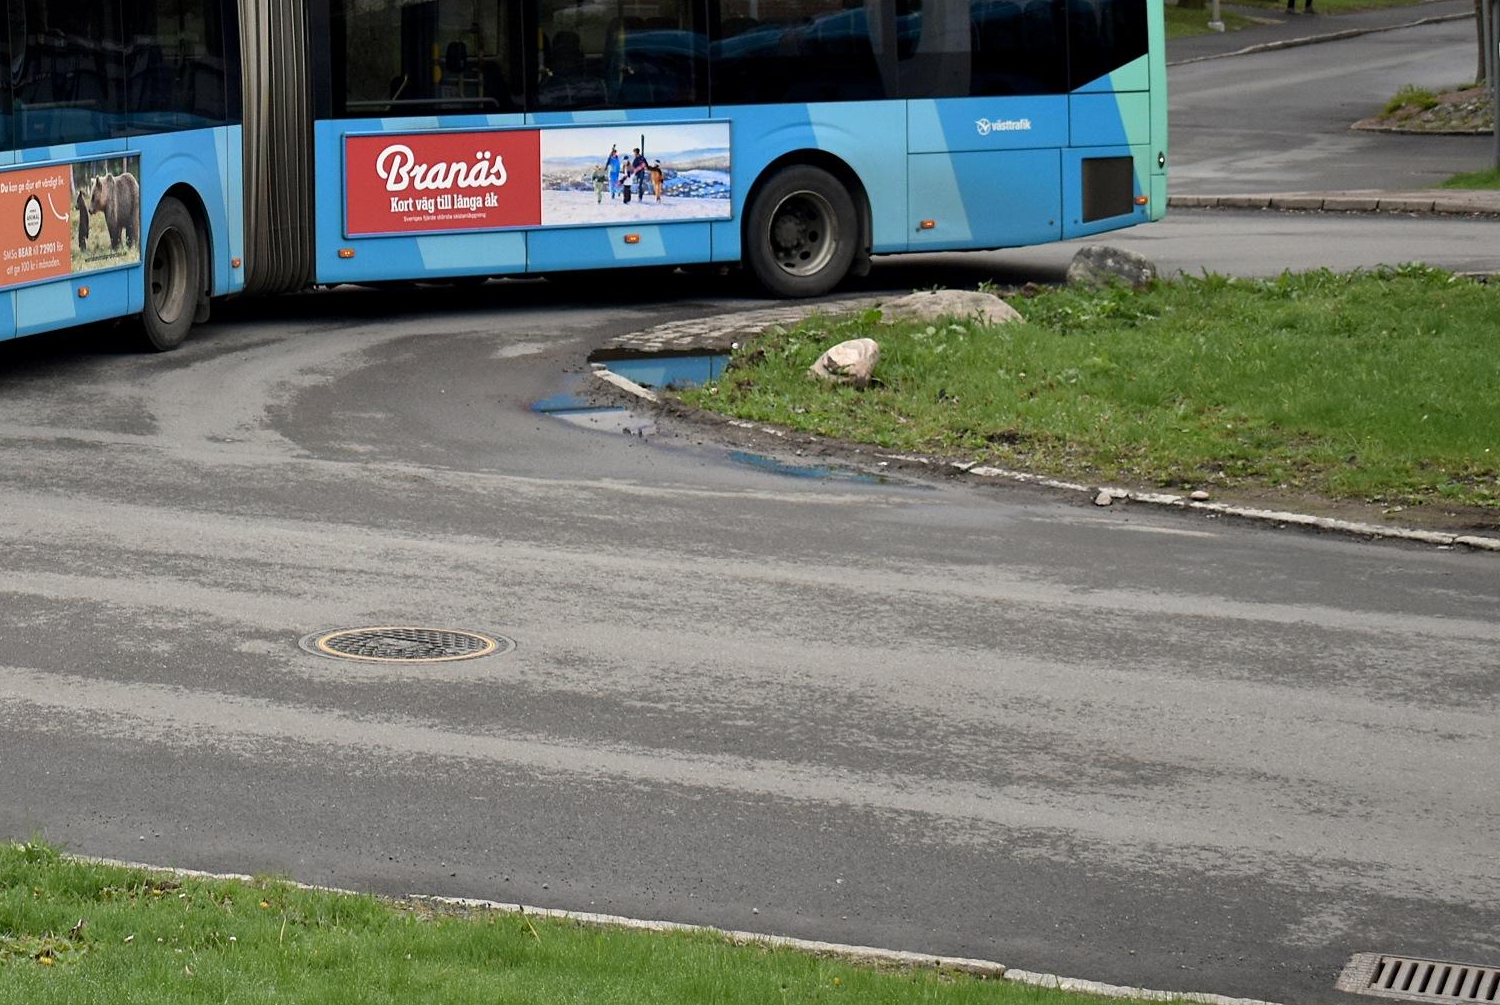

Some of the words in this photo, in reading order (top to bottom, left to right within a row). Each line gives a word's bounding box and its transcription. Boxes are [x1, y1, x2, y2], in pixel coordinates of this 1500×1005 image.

[990, 118, 1032, 132] västtrafik
[376, 144, 508, 192] Branäs
[390, 197, 414, 213] Kort
[415, 196, 435, 213] väg
[436, 194, 452, 210] till
[453, 193, 483, 212] långa
[484, 192, 499, 208] åk
